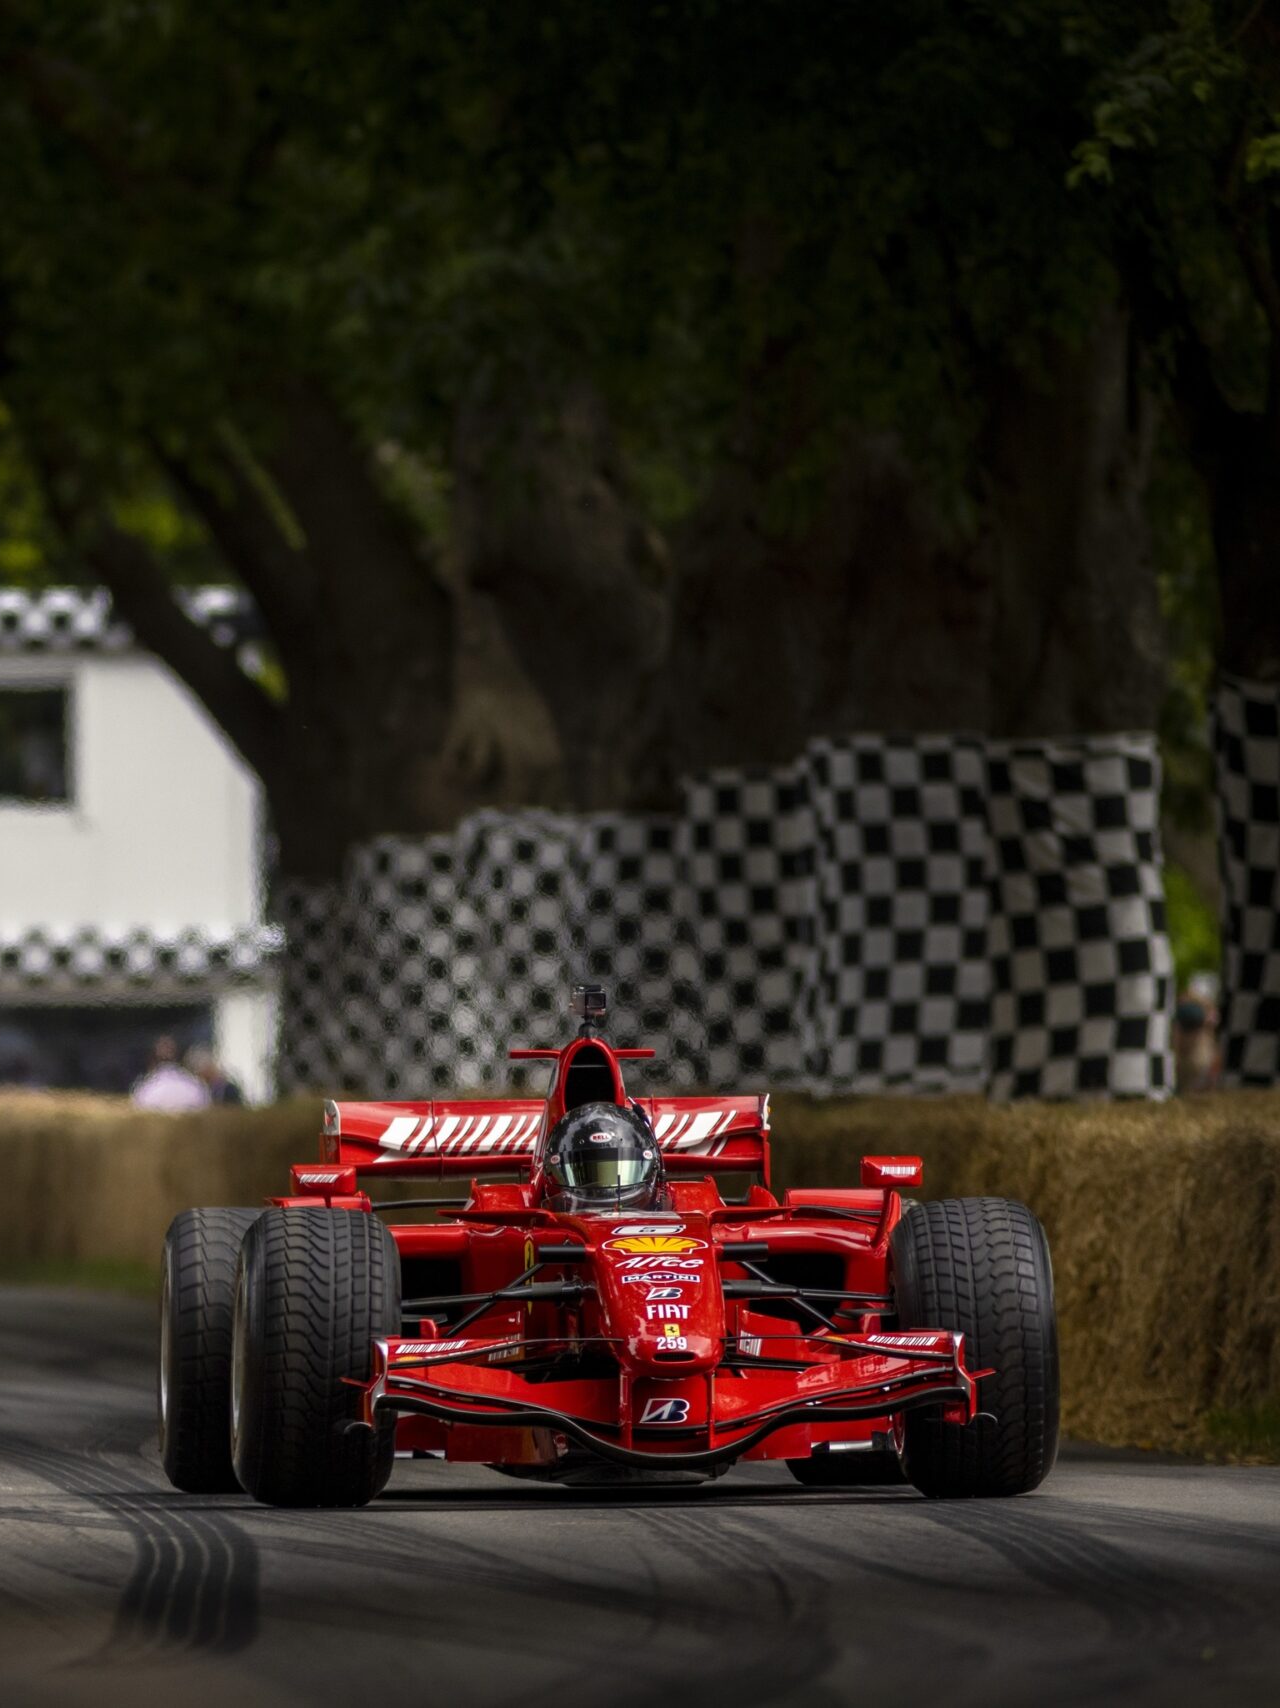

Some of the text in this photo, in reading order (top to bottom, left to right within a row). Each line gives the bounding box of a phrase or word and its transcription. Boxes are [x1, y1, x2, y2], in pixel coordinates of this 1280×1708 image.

[628, 1273, 694, 1281] MARTINI
[646, 1304, 692, 1319] FIAT
[657, 1336, 688, 1350] 259
